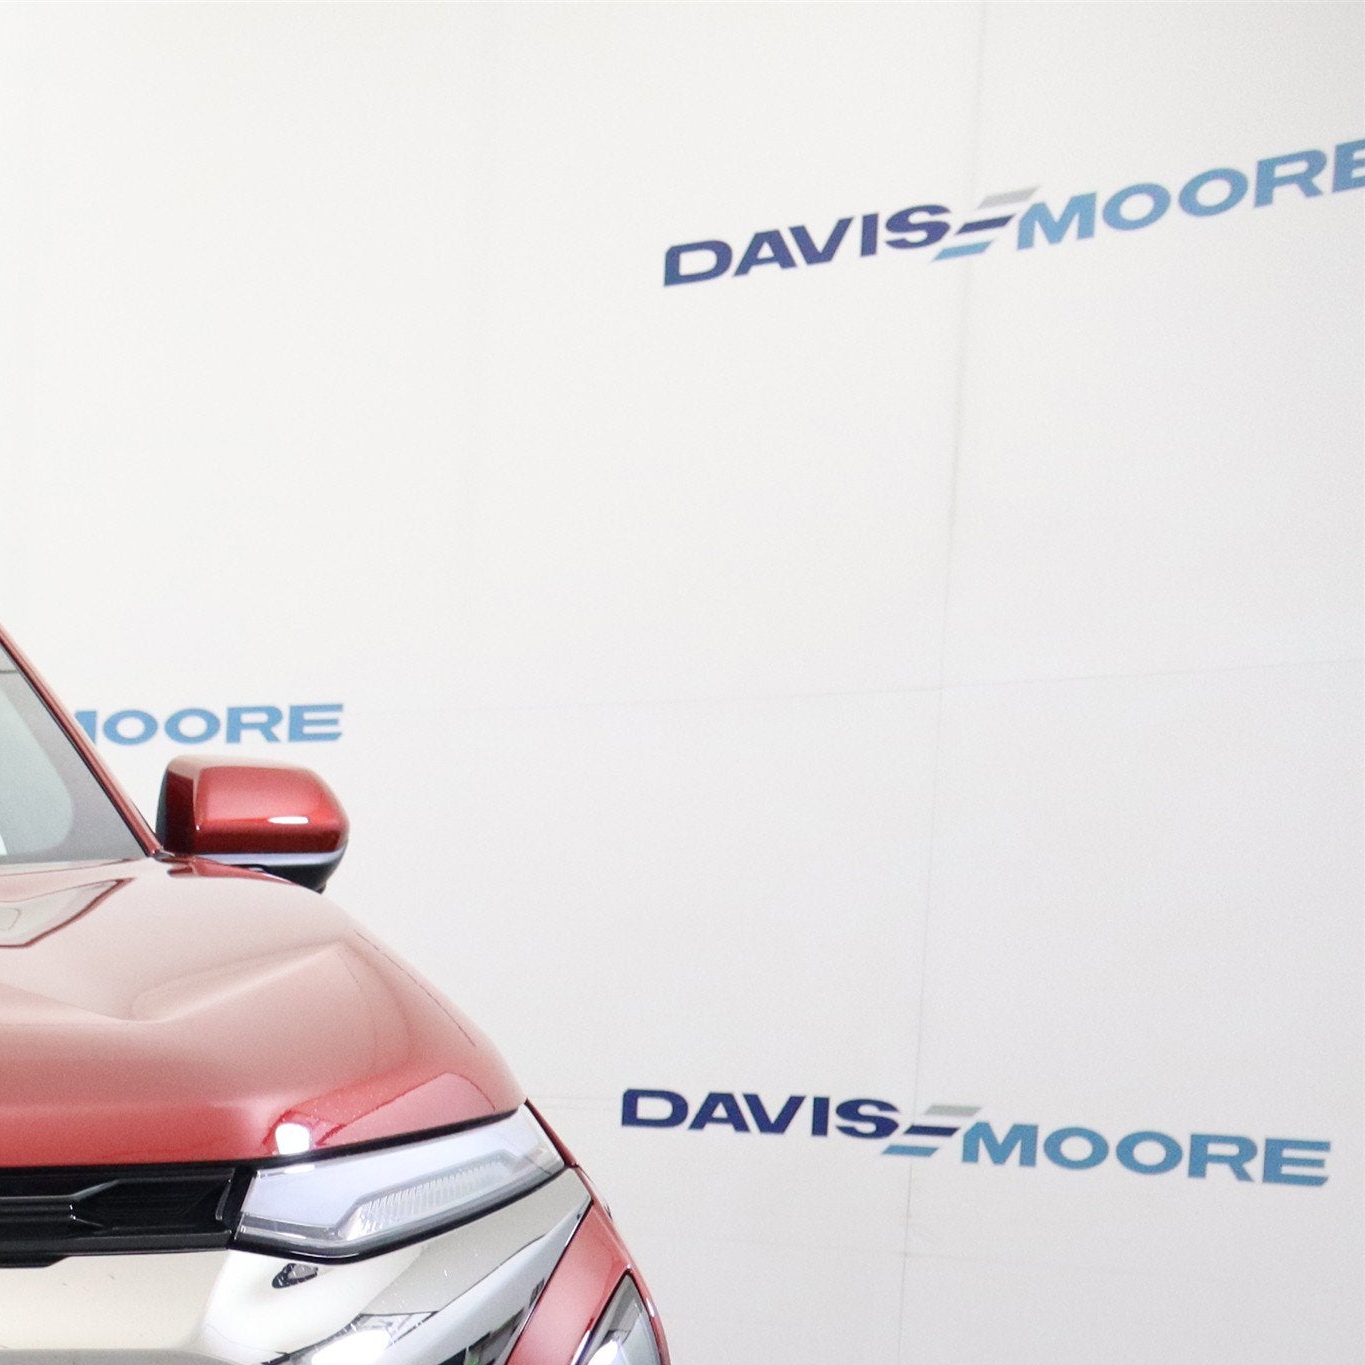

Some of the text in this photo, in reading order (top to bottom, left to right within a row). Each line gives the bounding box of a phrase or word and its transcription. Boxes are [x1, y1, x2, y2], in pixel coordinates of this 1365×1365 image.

[664, 205, 951, 287] DAVIS
[621, 1088, 1332, 1188] DAVIS MOORE
